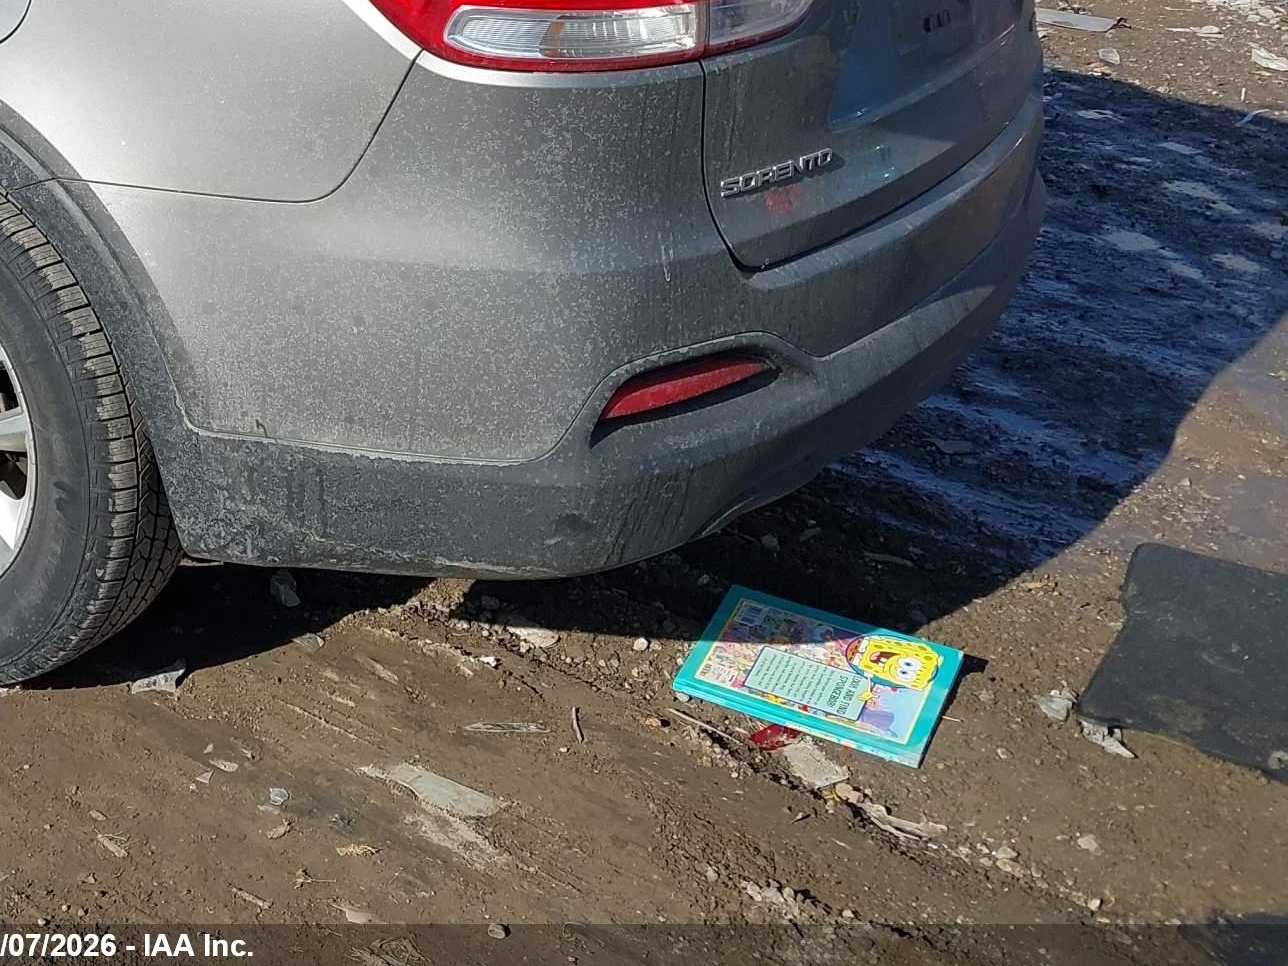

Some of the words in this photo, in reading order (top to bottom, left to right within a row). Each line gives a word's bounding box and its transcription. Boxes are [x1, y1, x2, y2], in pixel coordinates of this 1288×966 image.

[720, 147, 833, 197] SORENTO
[843, 689, 855, 701] AND
[836, 701, 850, 714] FIND
